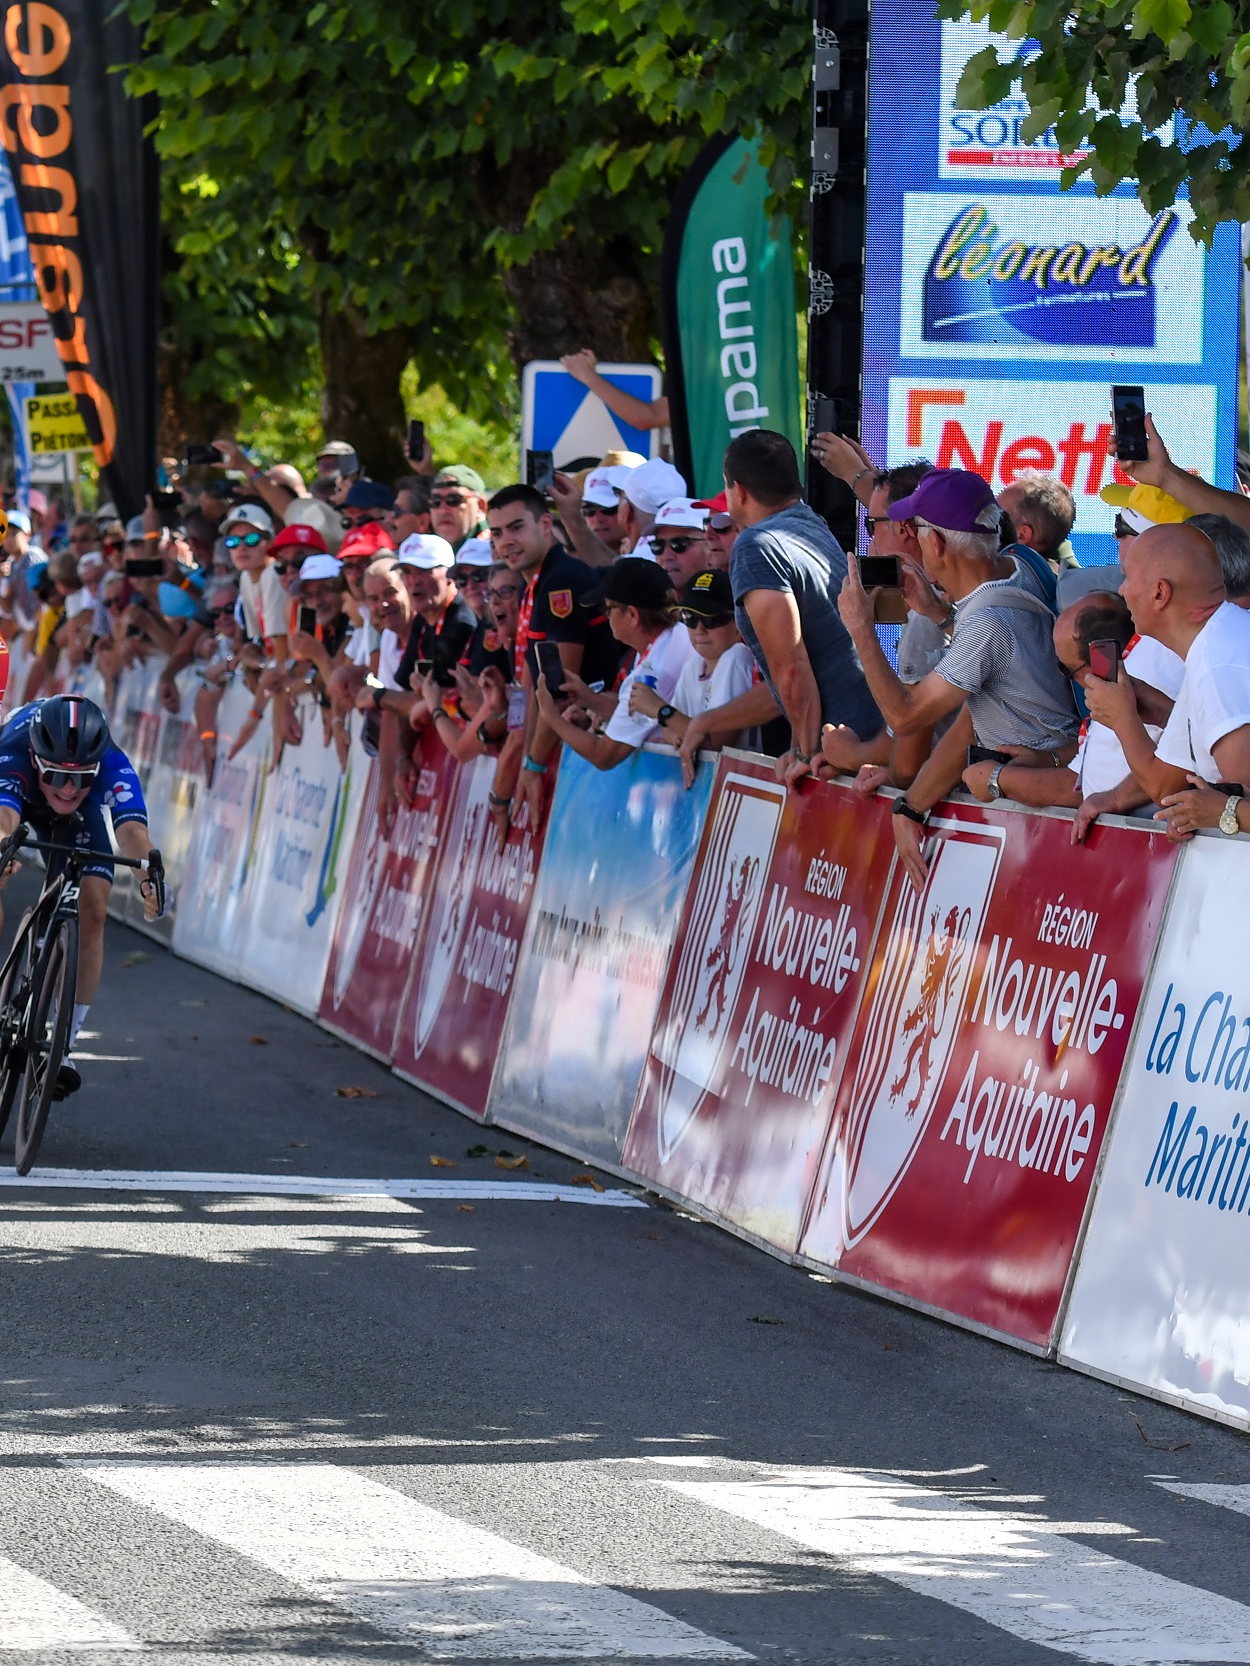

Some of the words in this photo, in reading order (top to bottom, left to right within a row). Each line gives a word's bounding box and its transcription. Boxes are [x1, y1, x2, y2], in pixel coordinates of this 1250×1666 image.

[2, 366, 45, 381] 25m
[711, 237, 769, 440] pama
[937, 420, 1140, 496] Nett
[805, 849, 848, 900] RÉGION
[1037, 893, 1098, 950] RÉGION
[457, 906, 518, 1004] Aquitaine
[755, 883, 860, 994] Nouvelle-
[971, 934, 1125, 1055] Nouvelle-
[1145, 982, 1186, 1075] la
[730, 986, 837, 1107] Aquitaine
[940, 1050, 1095, 1184] Aquitaine
